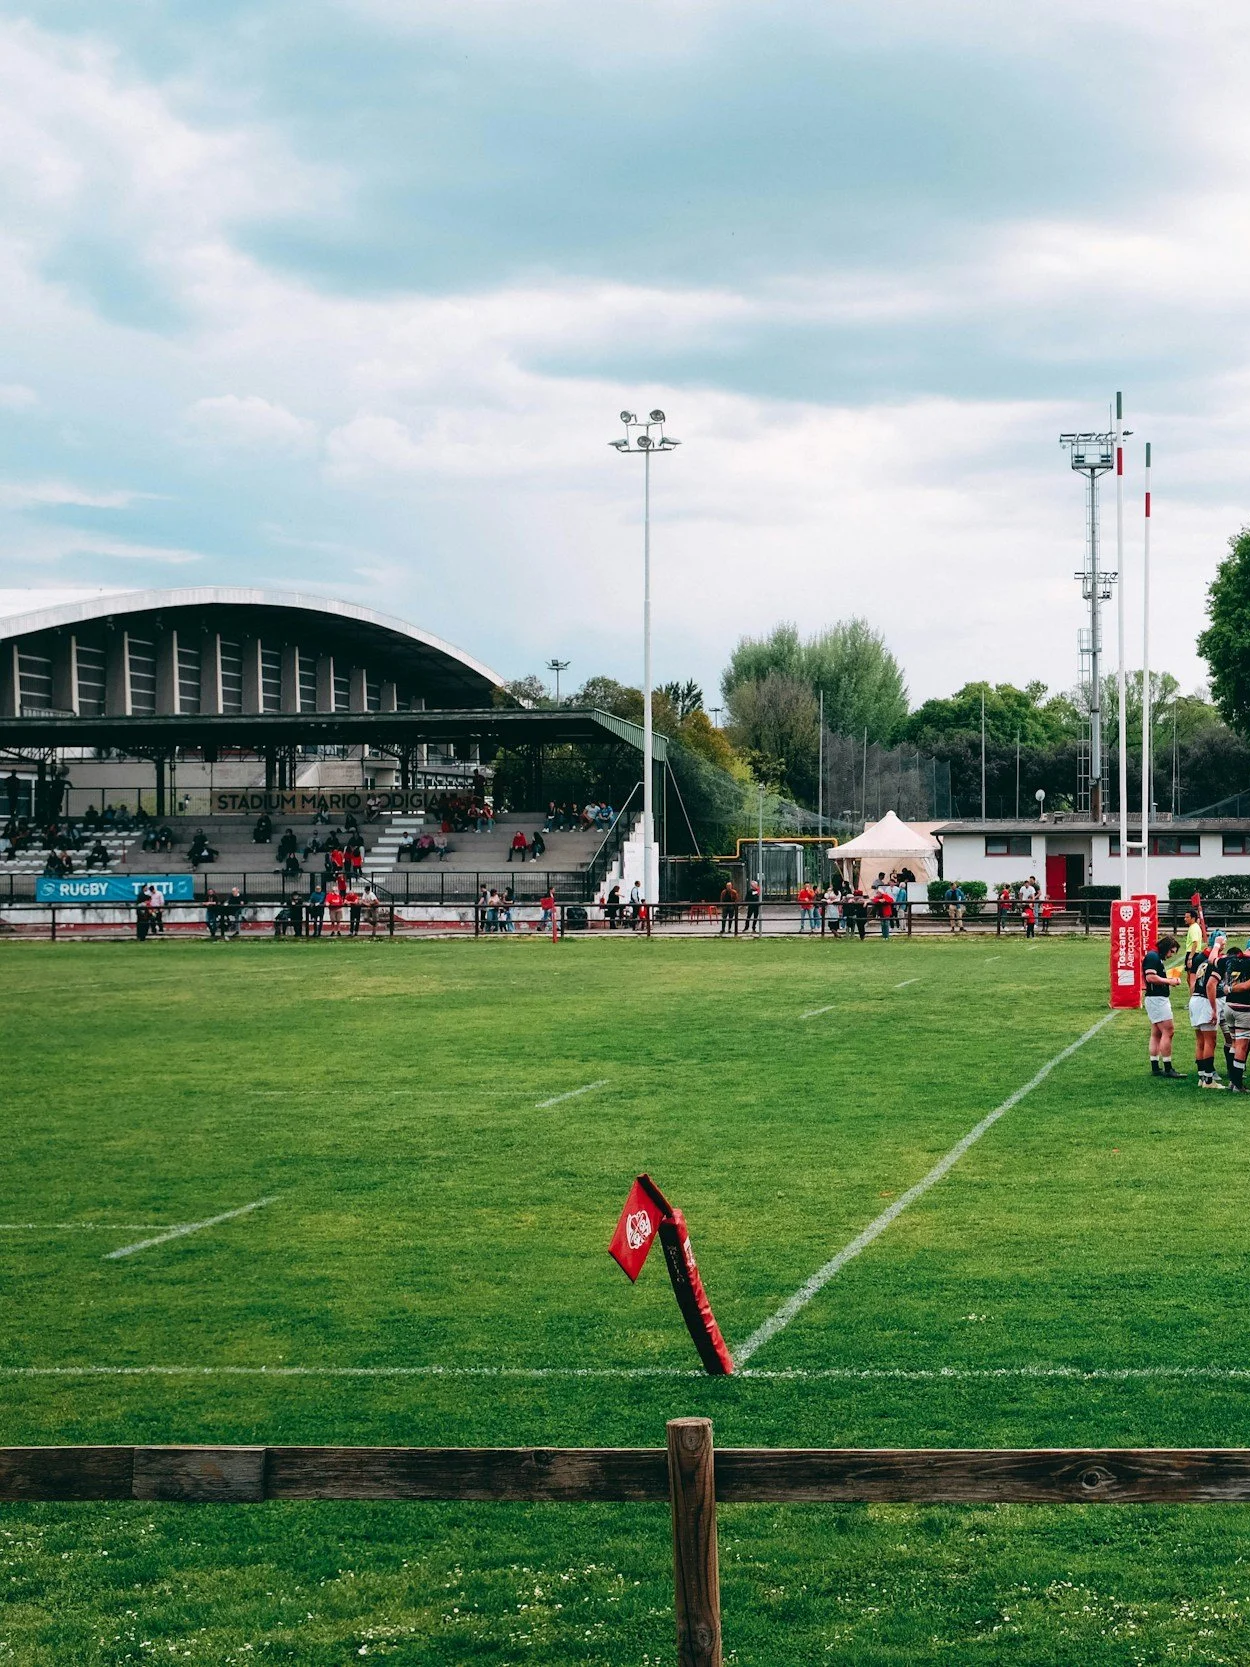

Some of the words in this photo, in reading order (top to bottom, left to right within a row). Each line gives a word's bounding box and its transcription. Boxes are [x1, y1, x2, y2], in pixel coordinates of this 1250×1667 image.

[217, 794, 296, 809] STADIUM
[302, 794, 361, 809] MARIO
[367, 793, 457, 809] ODIGIA
[59, 882, 108, 896] RUGBY
[131, 882, 173, 896] TTTI
[1117, 926, 1126, 968] Toscana
[1127, 926, 1135, 968] Aeroporti
